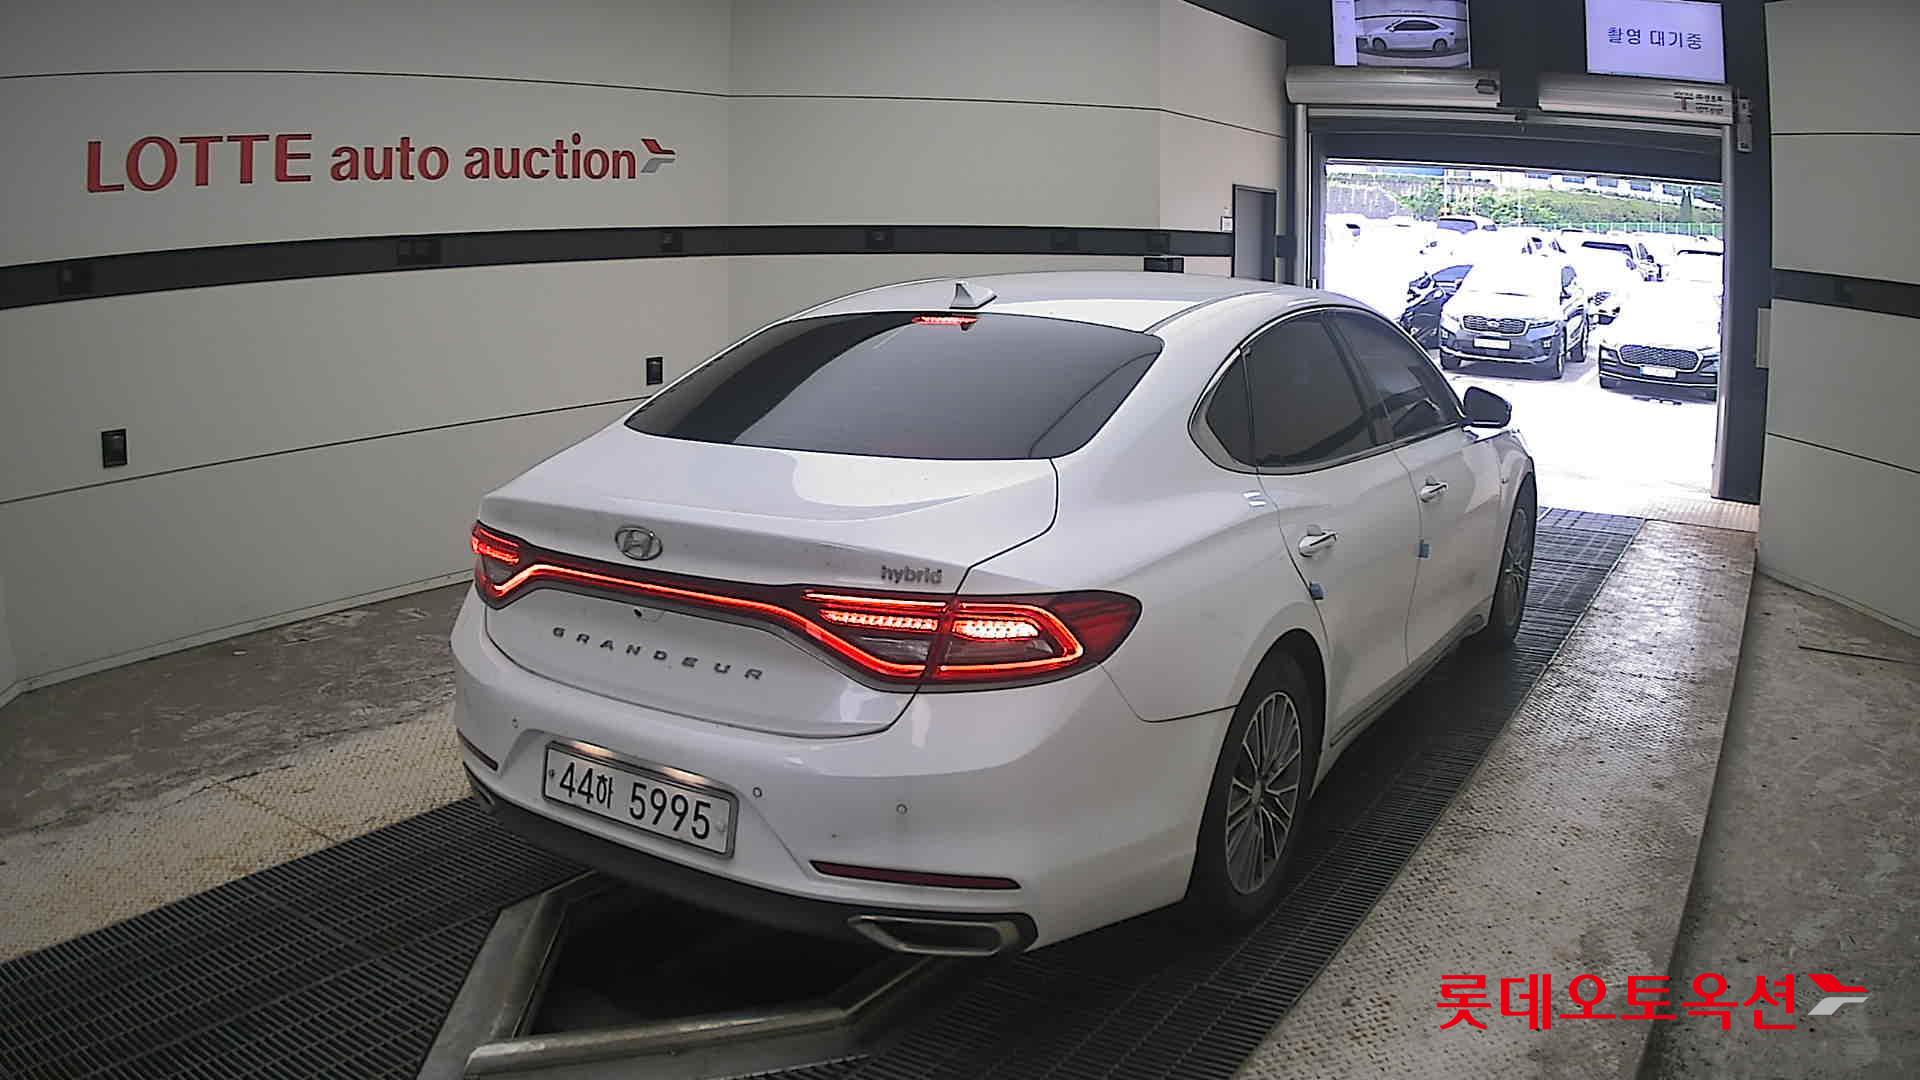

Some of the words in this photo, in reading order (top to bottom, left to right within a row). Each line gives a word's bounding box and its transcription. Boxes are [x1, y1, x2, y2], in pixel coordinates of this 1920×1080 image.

[1608, 27, 1641, 45] 촬영
[1649, 30, 1704, 50] 대기중
[87, 133, 312, 193] LOTTE
[330, 136, 449, 181] auto
[464, 132, 637, 180] auction
[881, 565, 943, 584] hybrid
[552, 626, 763, 680] GRANDEUR
[559, 761, 614, 809] 44하
[629, 782, 712, 840] 5995
